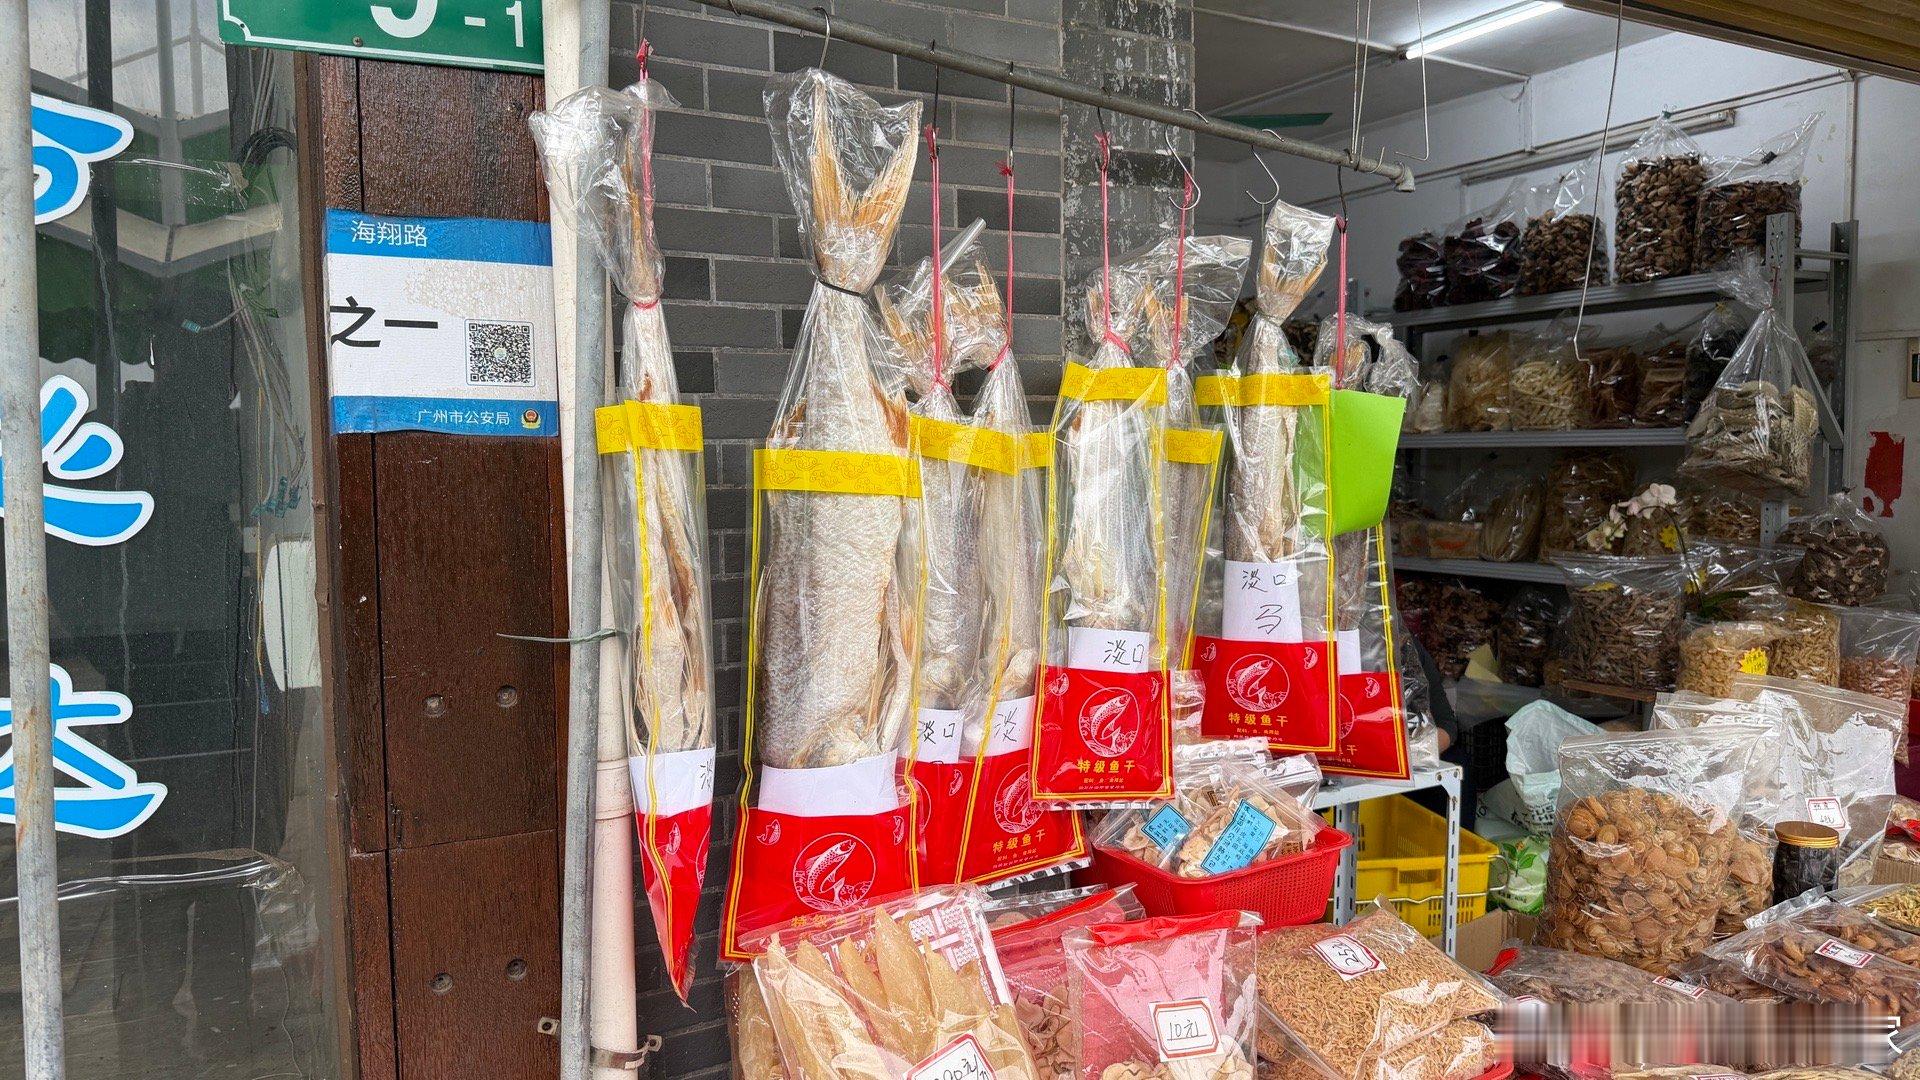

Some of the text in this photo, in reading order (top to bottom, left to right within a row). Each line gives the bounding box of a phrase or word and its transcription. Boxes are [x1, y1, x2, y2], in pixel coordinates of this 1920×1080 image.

[351, 219, 428, 248] 海翔路
[329, 295, 438, 347] 之一
[417, 409, 510, 426] 广州市公安局
[1241, 569, 1286, 593] 淡口
[1102, 639, 1145, 666] 淡口
[994, 707, 1017, 742] 淡
[1228, 712, 1289, 728] 特级鱼干
[917, 720, 955, 745] 淡口
[1077, 759, 1136, 774] 特级鱼干
[992, 830, 1046, 853] 特级鱼干
[1170, 1019, 1199, 1041] 10元
